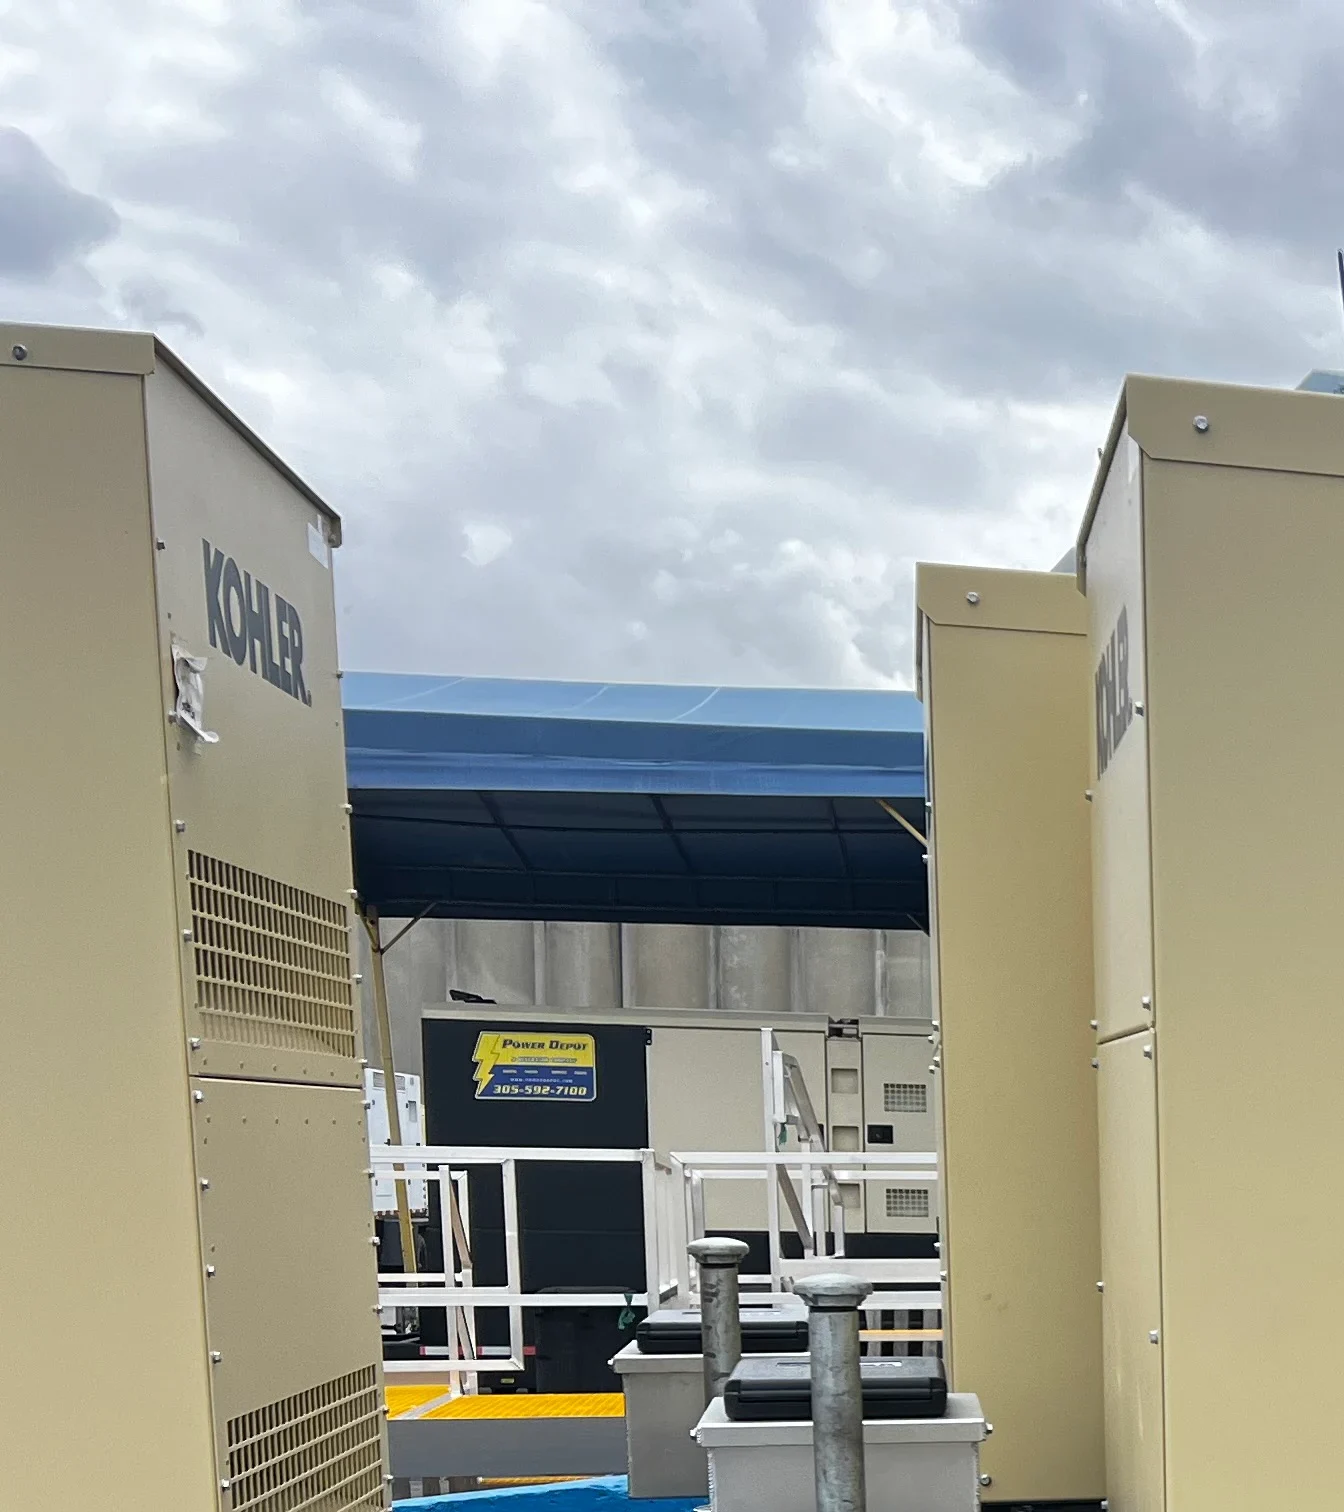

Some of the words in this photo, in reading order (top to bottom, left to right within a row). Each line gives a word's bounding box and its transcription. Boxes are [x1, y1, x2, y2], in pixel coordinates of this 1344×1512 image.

[202, 537, 310, 707] KOHLER
[502, 1039, 545, 1050] POWER
[549, 1040, 588, 1050] DEPOT
[493, 1084, 587, 1095] 305-592-7100
